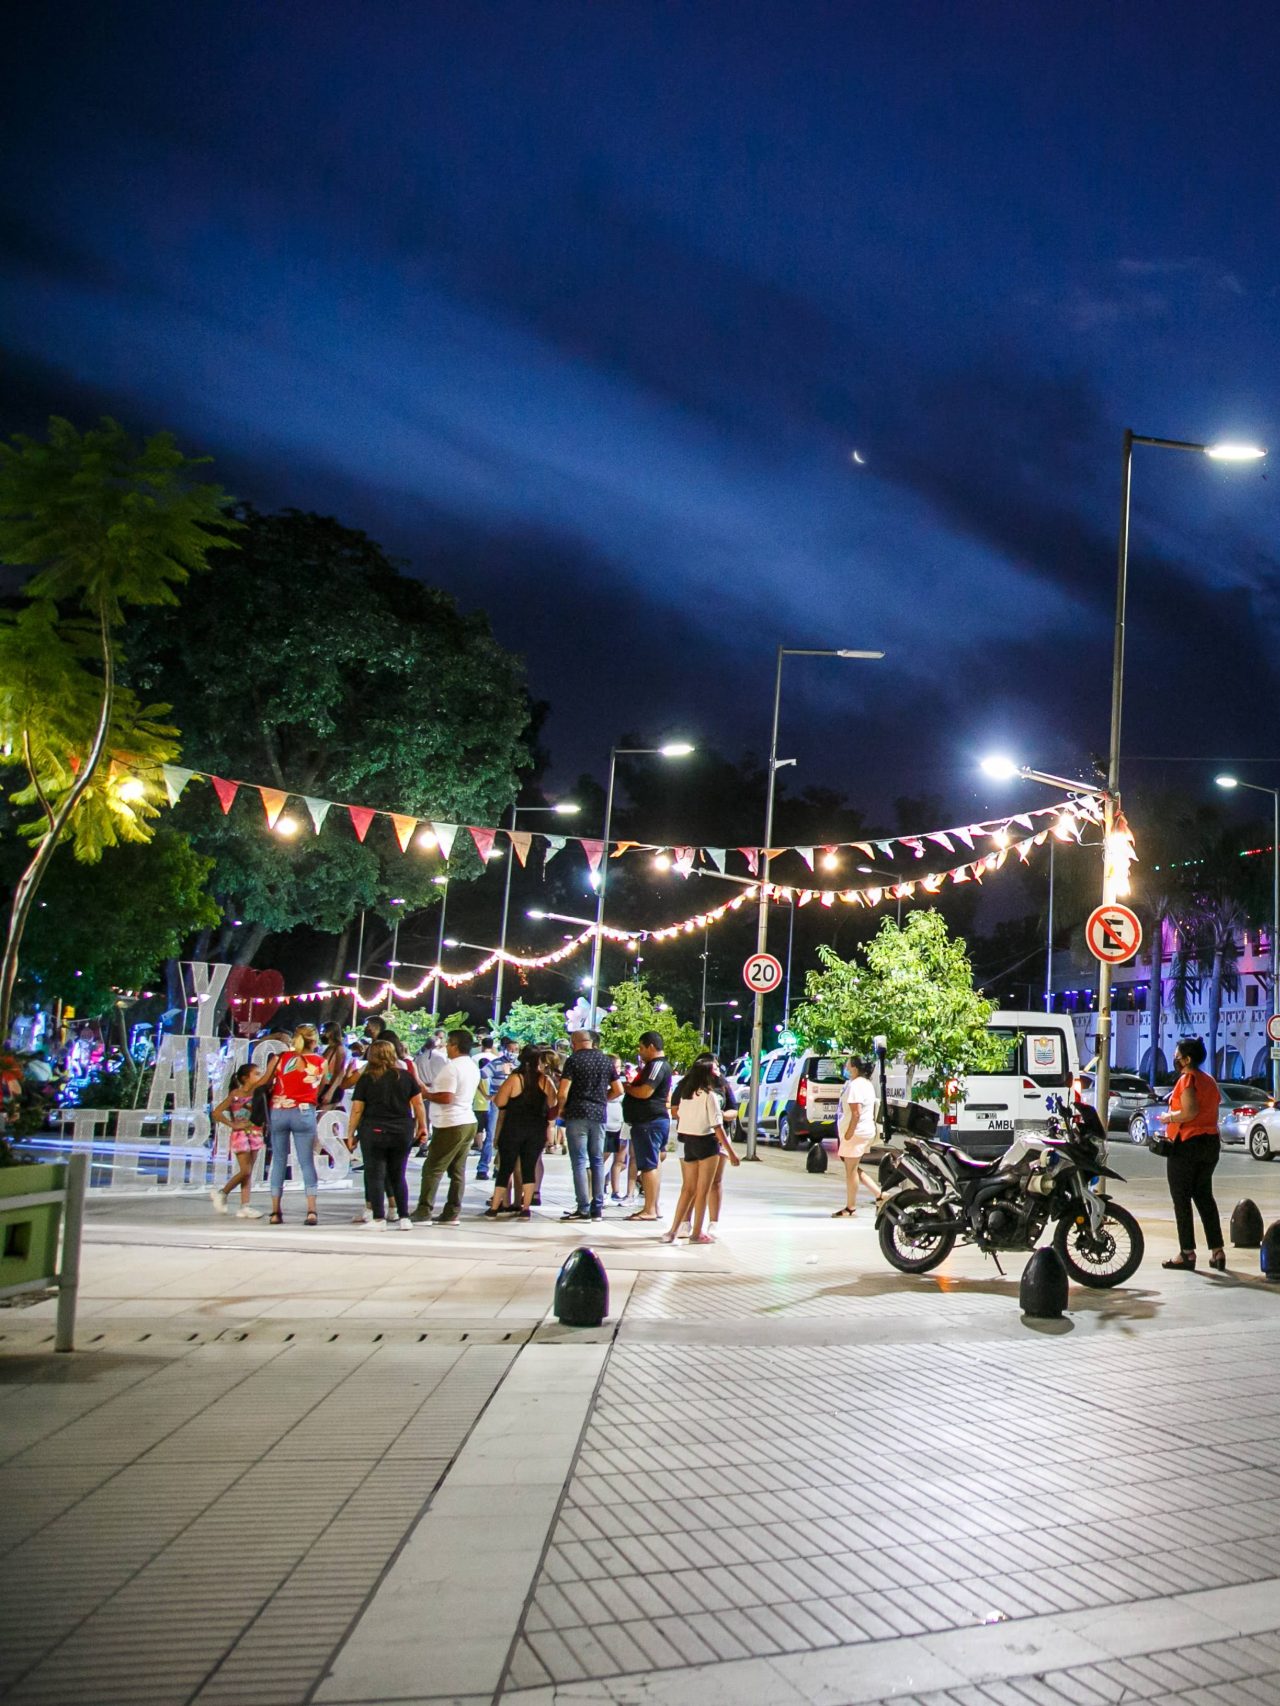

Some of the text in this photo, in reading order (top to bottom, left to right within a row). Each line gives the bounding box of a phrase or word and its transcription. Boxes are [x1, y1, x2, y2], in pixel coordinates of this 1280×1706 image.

[1103, 919, 1123, 949] E
[751, 963, 775, 982] 20
[51, 1109, 352, 1187] TERS
